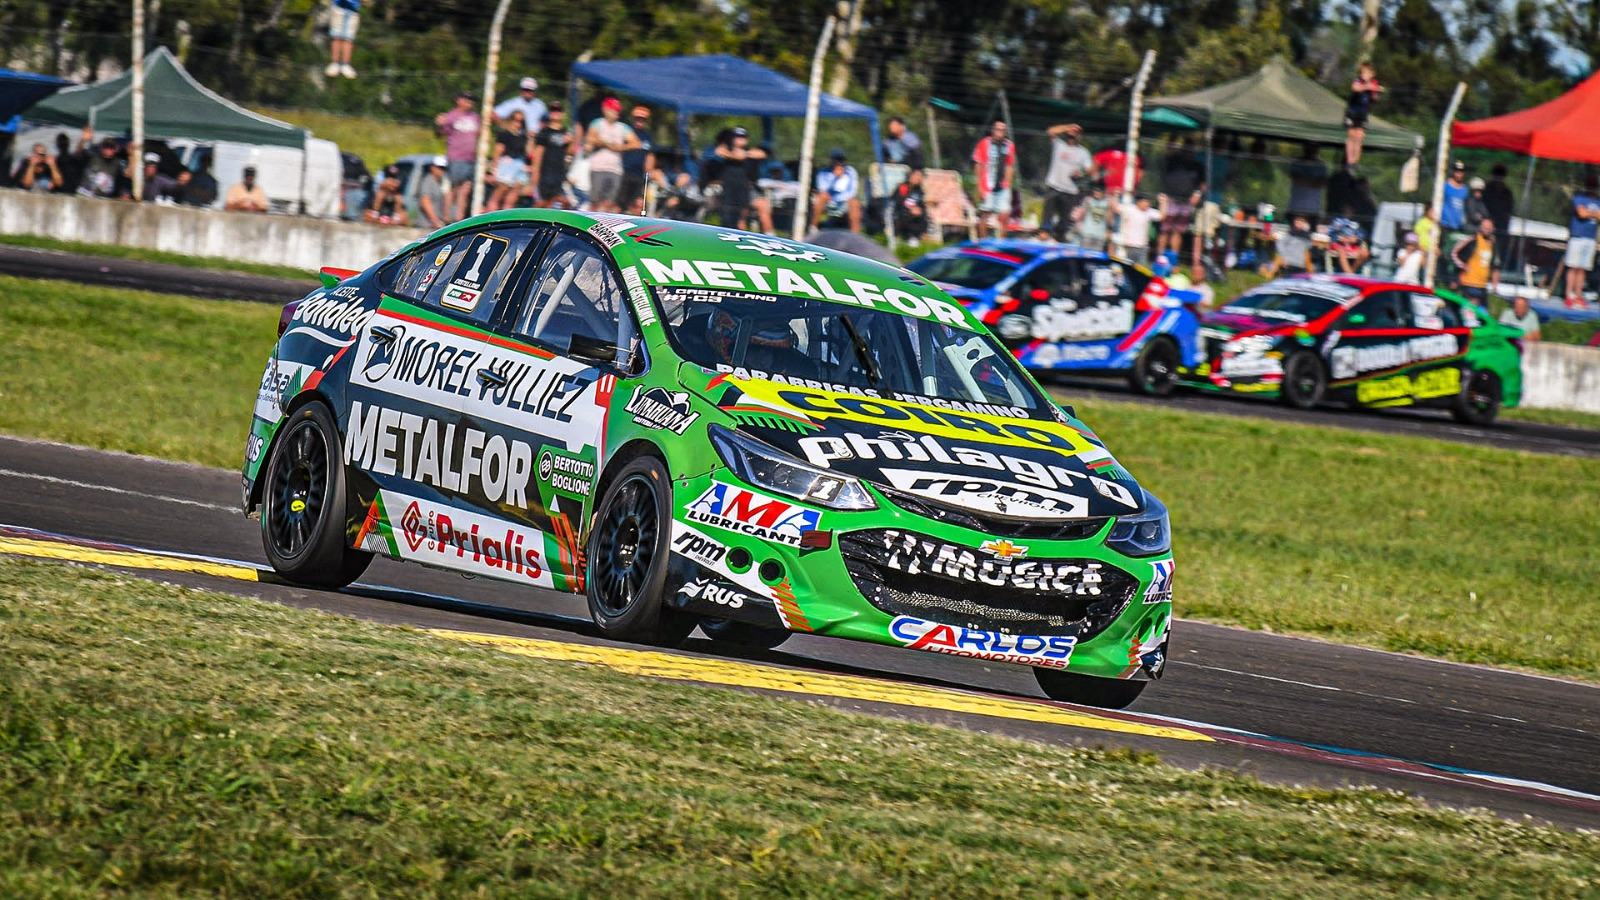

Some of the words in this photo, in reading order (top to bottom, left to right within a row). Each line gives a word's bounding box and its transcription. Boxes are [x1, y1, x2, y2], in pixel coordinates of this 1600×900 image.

[464, 238, 494, 282] 1
[639, 257, 975, 332] METALFOR
[393, 336, 482, 398] MOREL
[716, 363, 881, 399] PARABRISAS
[777, 390, 1077, 451] COIRO
[343, 400, 532, 510] METALFOR
[553, 455, 594, 478] BERTOTTO
[797, 432, 1139, 509] philagro
[551, 473, 591, 496] BOGLIONE
[811, 475, 840, 500] 1
[691, 482, 823, 536] AMA
[435, 513, 542, 579] Prialis
[673, 531, 727, 562] rpm
[701, 583, 748, 609] RUS
[891, 617, 1074, 659] CARLOS
